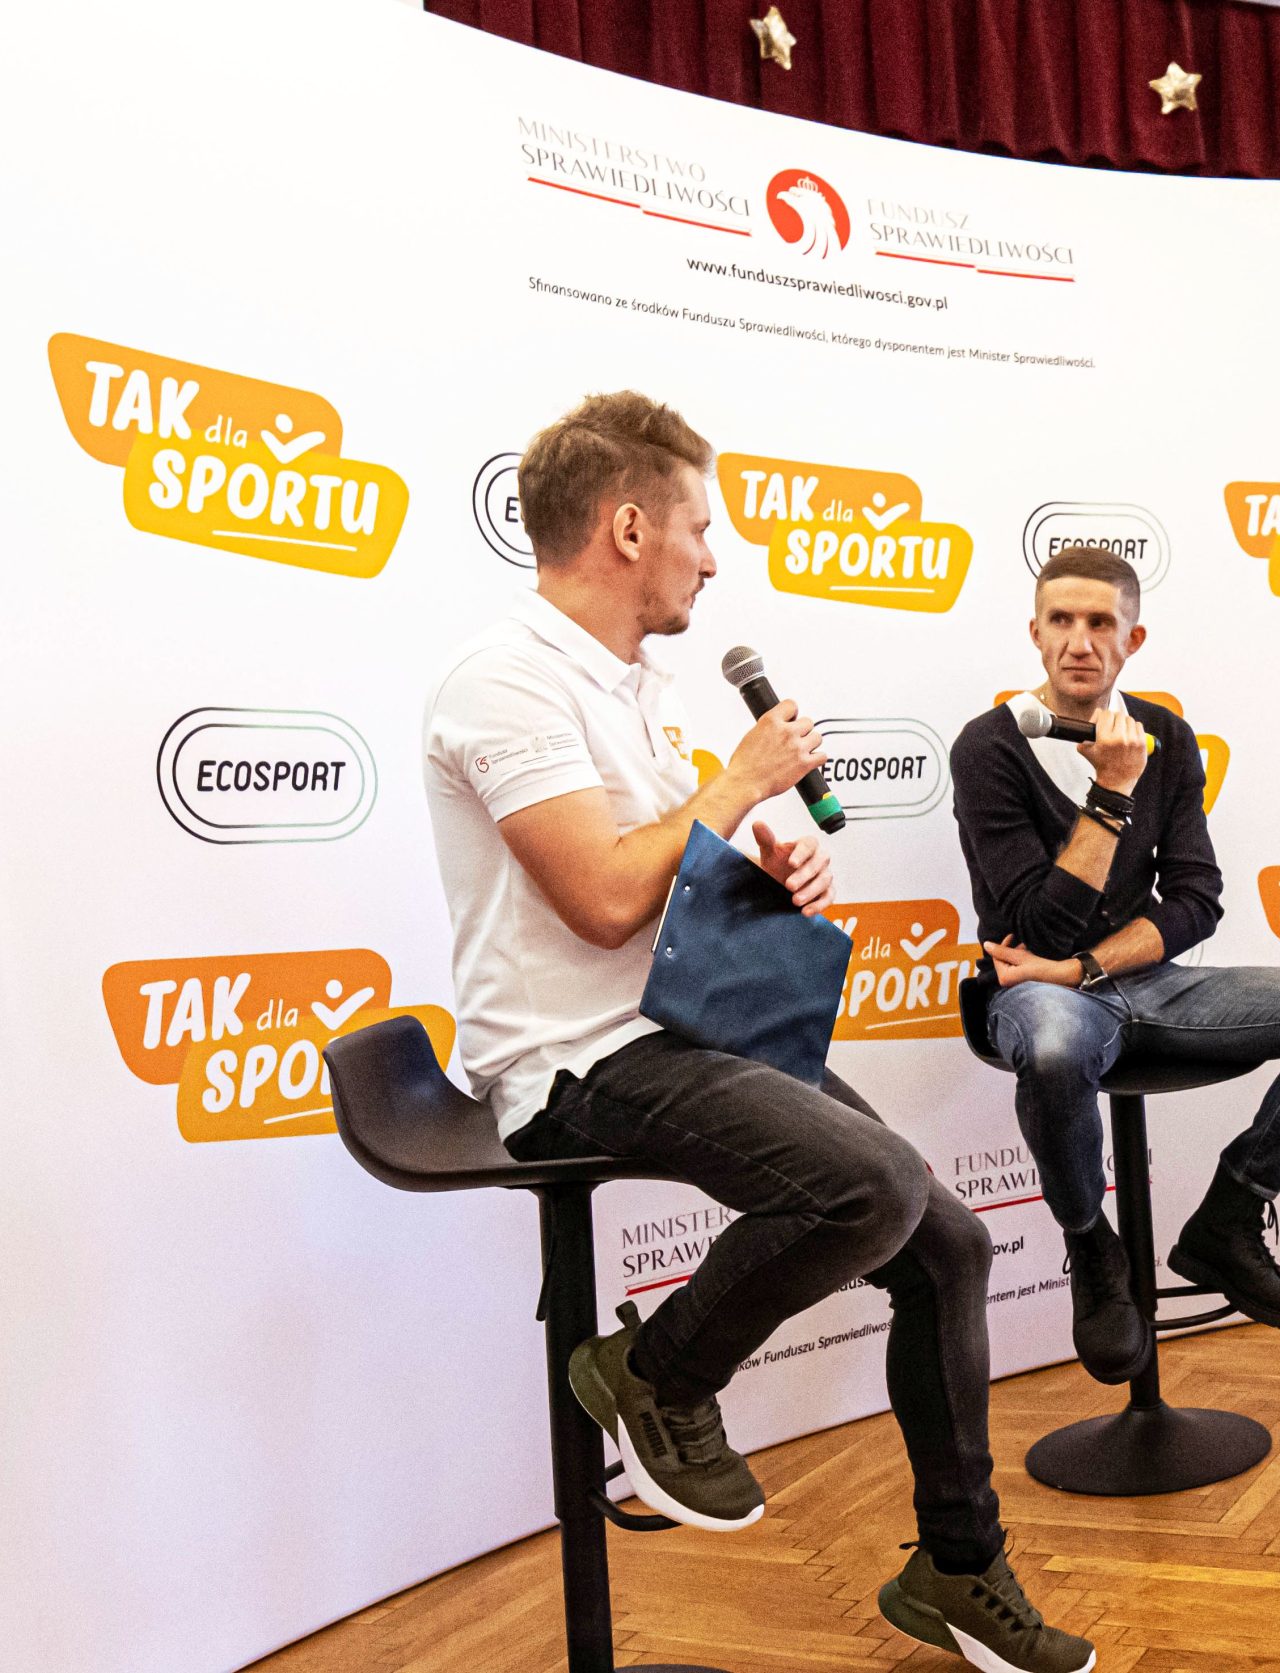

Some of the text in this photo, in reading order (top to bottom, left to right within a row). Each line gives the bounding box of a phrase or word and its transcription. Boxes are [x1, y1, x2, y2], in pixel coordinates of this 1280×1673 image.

[518, 116, 706, 183] MINISTERSTWO
[521, 143, 751, 217] SPRAWIEDLIWOŚCI
[867, 199, 972, 230] FUNDUSZ
[870, 222, 1075, 264] SPRAWIEDLIWOŚCI
[686, 257, 949, 311] www.funduszsprawiedliwosci.gov.pl
[528, 276, 612, 306] Sfinansowano
[615, 298, 628, 309] ze
[631, 298, 680, 320] środków
[682, 307, 736, 328] Funduszu
[738, 317, 829, 344] Sprawiedliwości,
[831, 331, 872, 350] którego
[874, 340, 945, 357] dysponentem
[946, 345, 966, 360] jest
[968, 348, 1011, 363] Minister
[85, 360, 249, 449] TAK dla
[148, 448, 380, 536] SPORTU
[741, 470, 854, 524] TAK dla
[784, 529, 952, 581] SPORTU
[196, 759, 347, 793] ECOSPORT
[821, 755, 927, 783] ECOSPORT
[861, 935, 892, 961] dla
[139, 972, 299, 1050] TAK dla
[201, 1036, 334, 1114] SPO
[1016, 1284, 1036, 1300] jest
[1038, 1276, 1070, 1293] Minist
[763, 1341, 815, 1365] Funduszu
